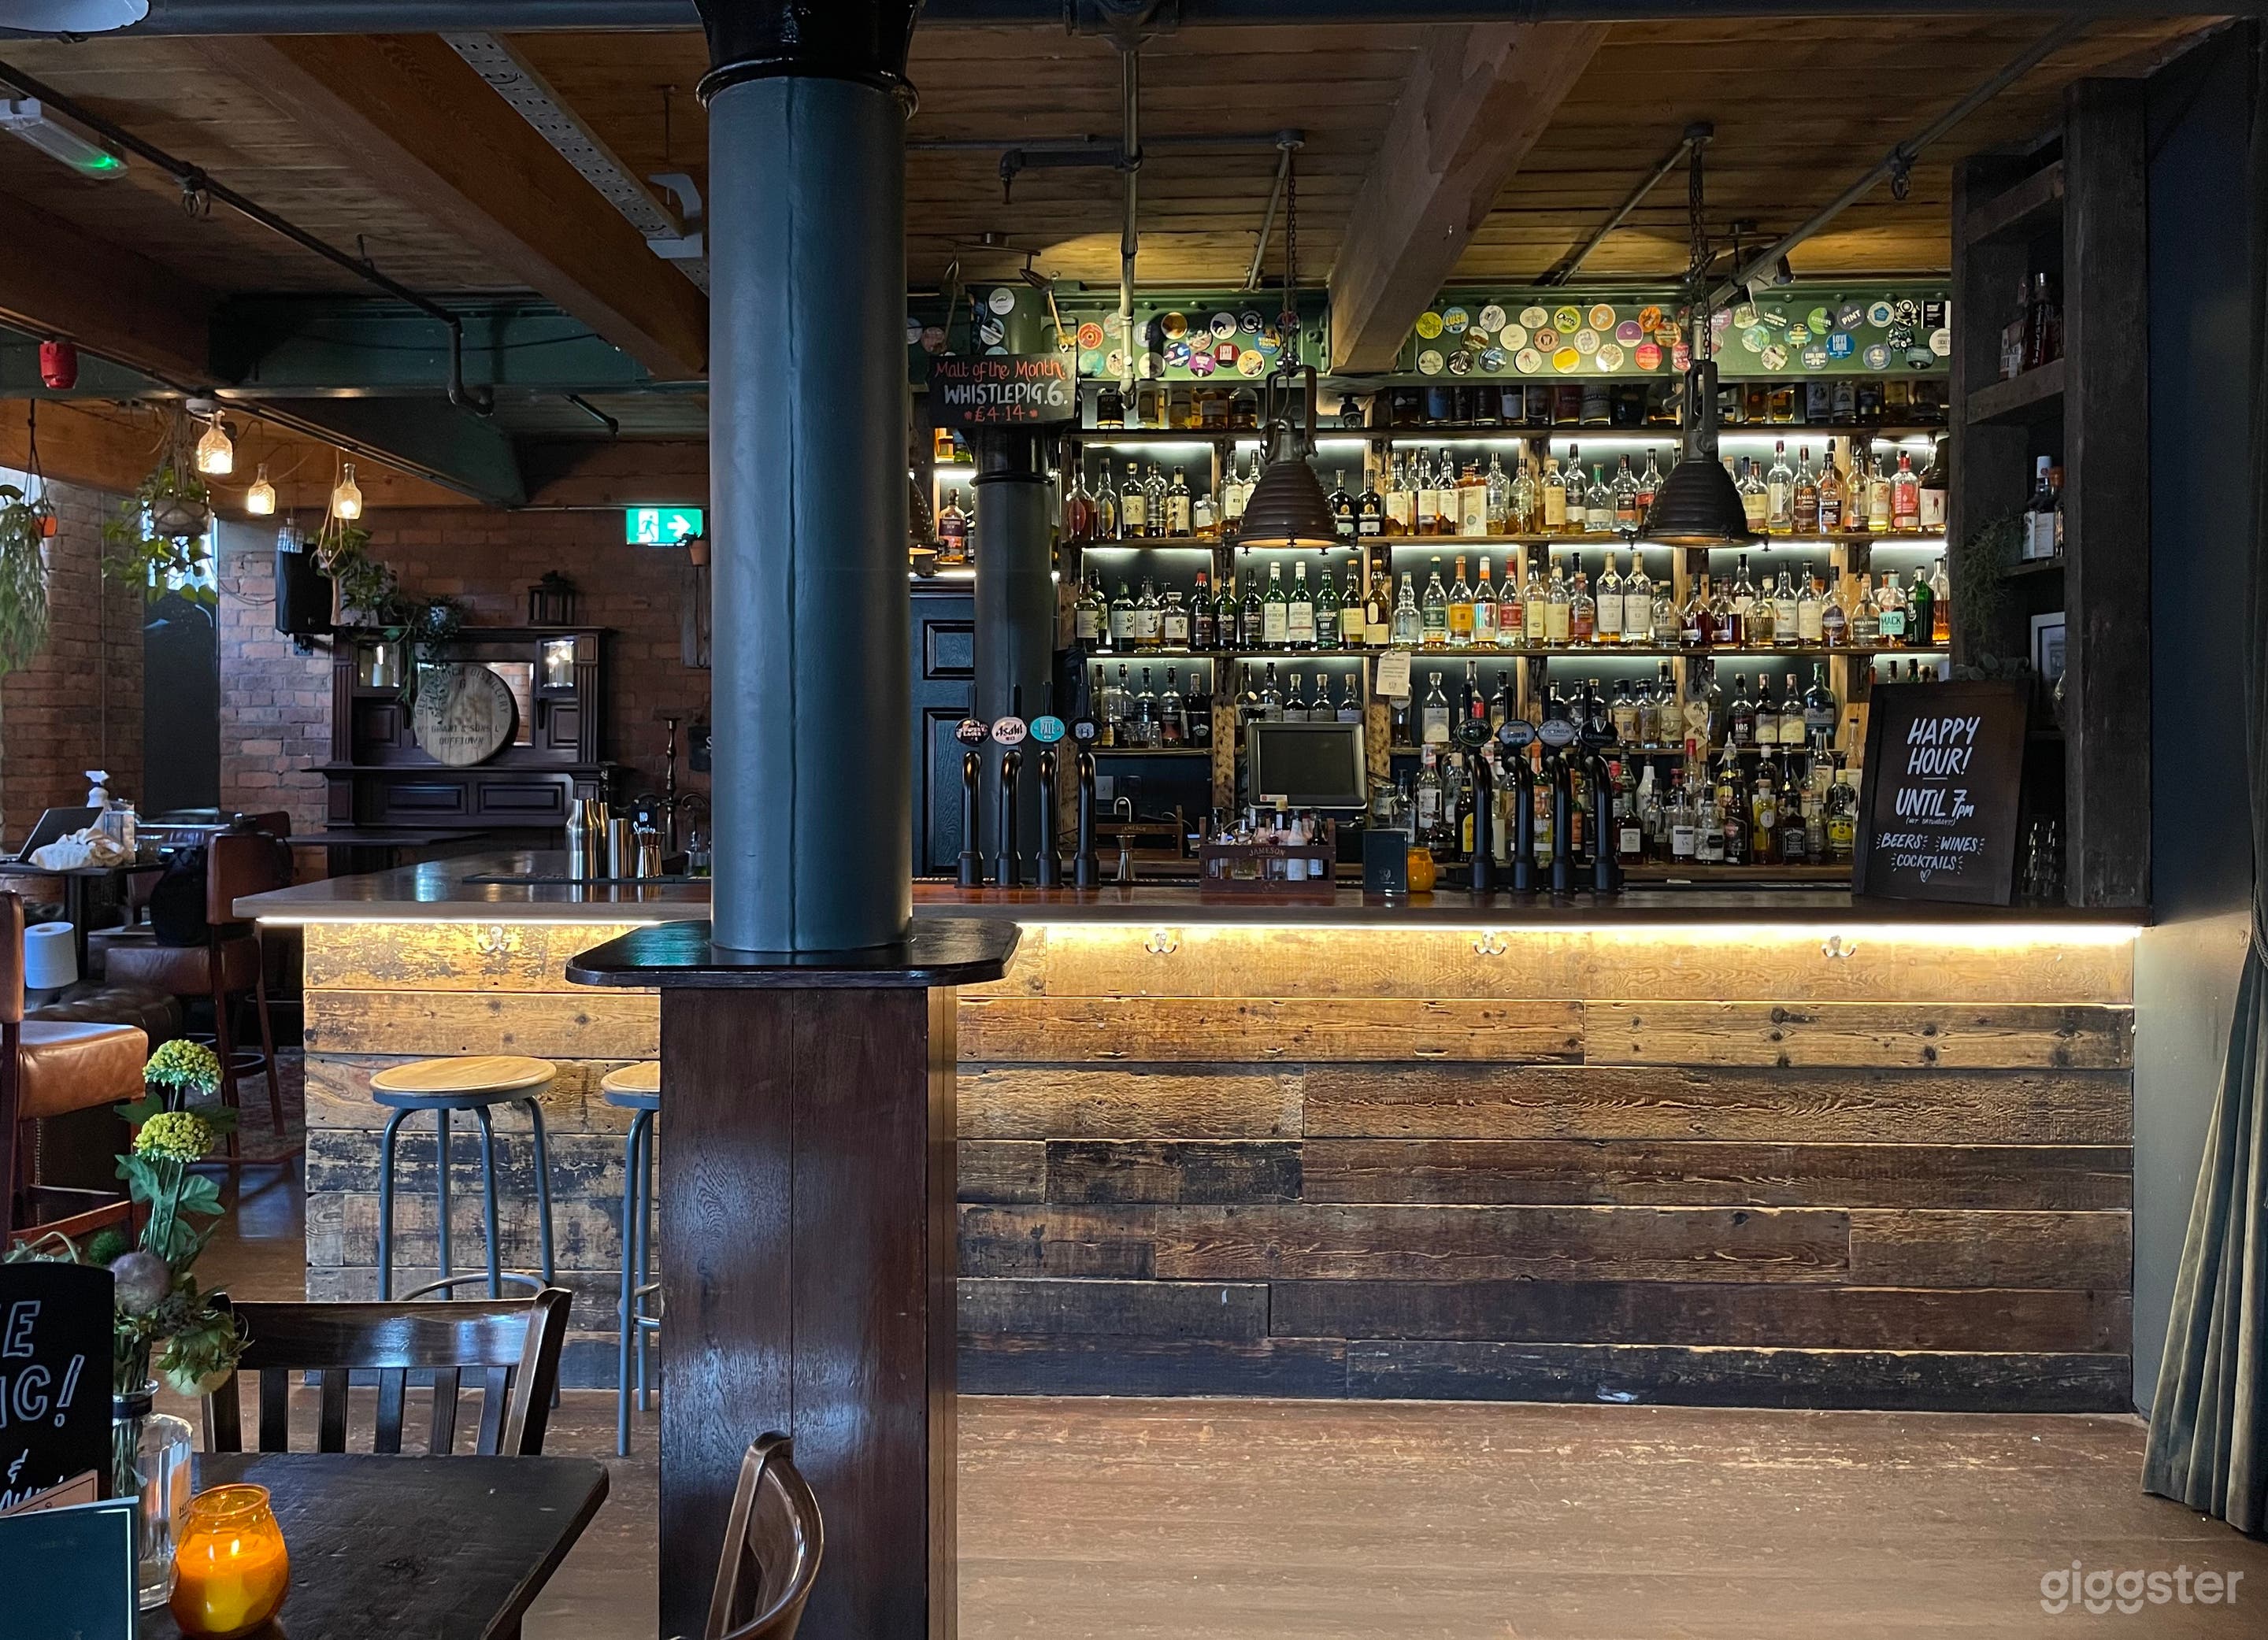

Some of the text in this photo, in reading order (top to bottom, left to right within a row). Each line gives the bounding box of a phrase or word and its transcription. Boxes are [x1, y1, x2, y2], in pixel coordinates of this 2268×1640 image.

[1841, 309, 1861, 324] PINT
[935, 359, 1066, 383] Malt of the Month
[995, 723, 1024, 738] Asahi
[1040, 723, 1055, 735] PALE
[1735, 723, 1748, 731] 105
[1907, 716, 1981, 746] HAPPY
[1907, 746, 1973, 776] HOUR!
[1896, 787, 1947, 817] UNTIL
[1880, 832, 1979, 852] BEERS WINES
[1248, 847, 1286, 857] JAMESON
[1896, 853, 1958, 871] COCKTAILS
